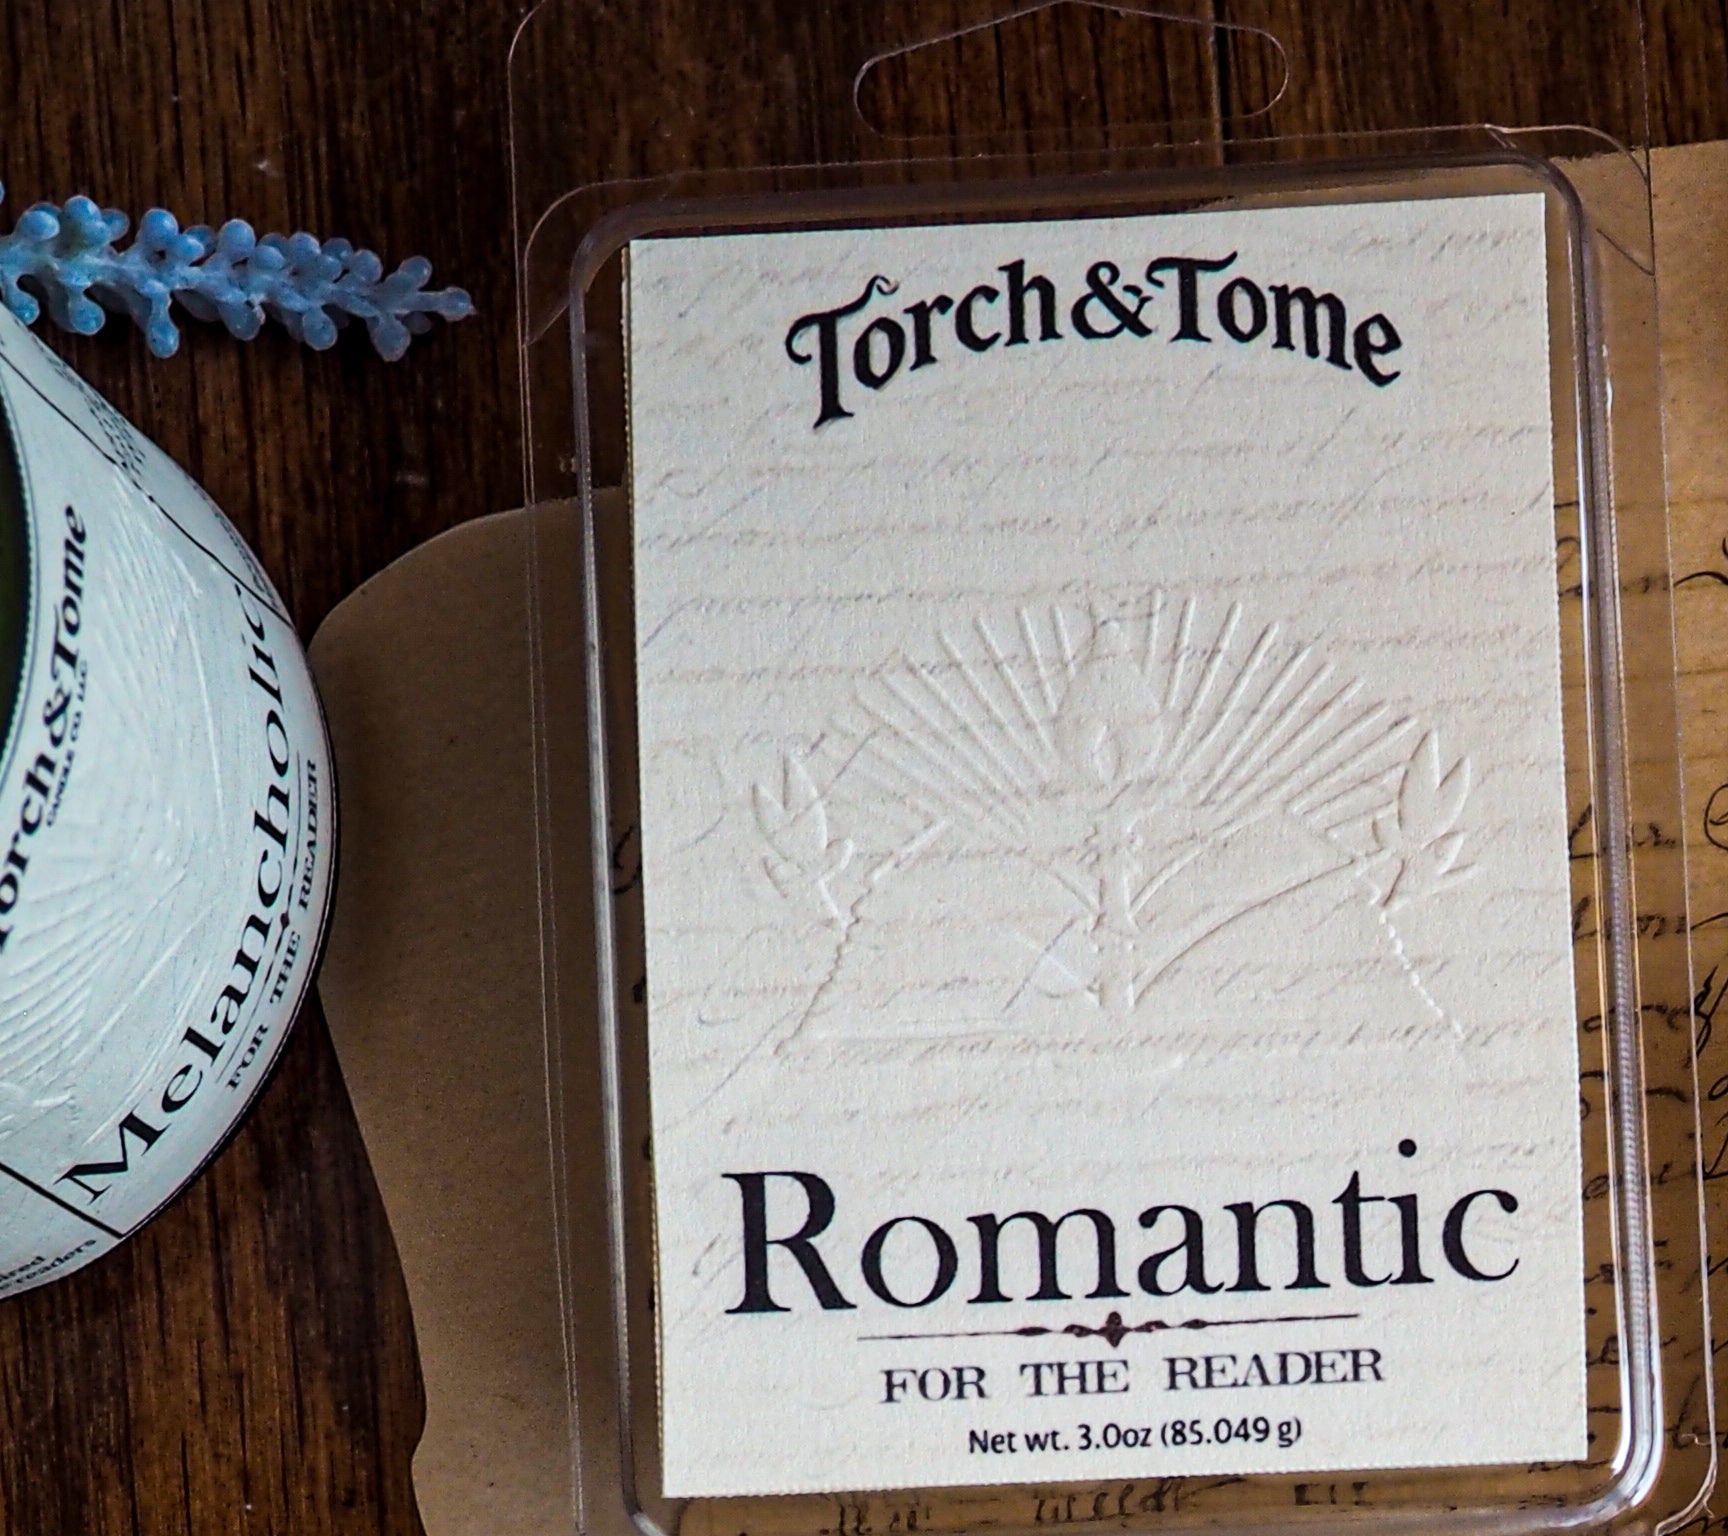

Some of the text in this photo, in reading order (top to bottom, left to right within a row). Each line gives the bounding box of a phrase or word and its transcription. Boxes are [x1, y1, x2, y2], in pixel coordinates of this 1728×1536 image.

[785, 251, 1402, 430] Torch&Tome
[0, 505, 88, 955] orch&Tome
[55, 583, 292, 1204] Melancholic
[226, 759, 319, 1094] FOR THE READER
[721, 1139, 1519, 1318] Romantic
[884, 1349, 1382, 1402] FOR THE READER
[967, 1428, 1019, 1456] Net
[1023, 1429, 1071, 1454] wt.
[1076, 1421, 1154, 1452] 3.0oz
